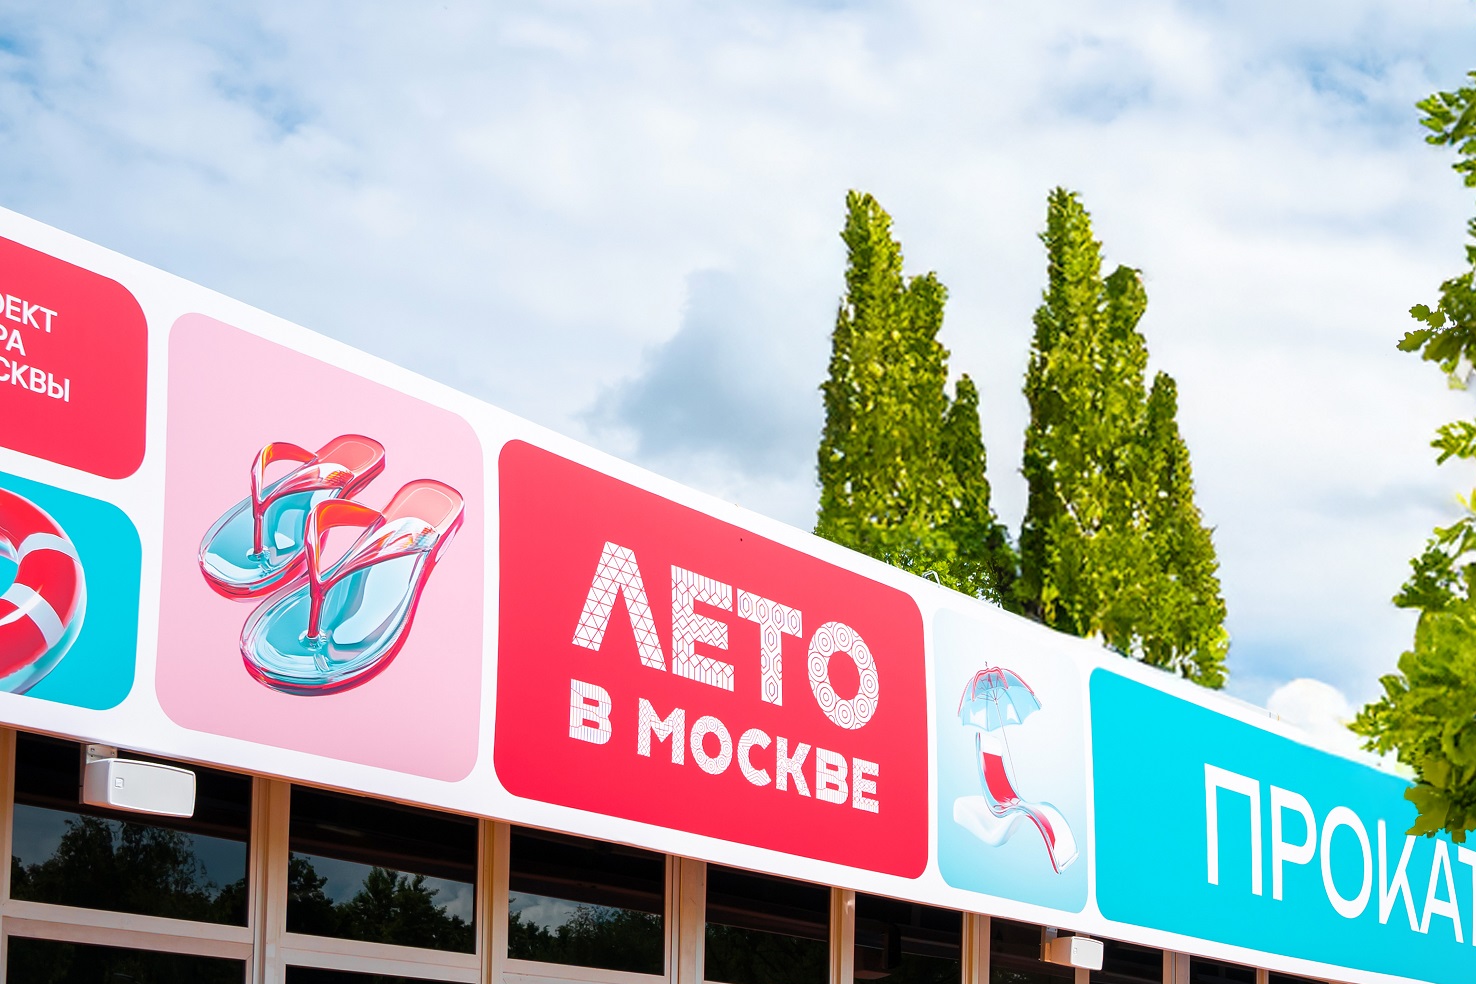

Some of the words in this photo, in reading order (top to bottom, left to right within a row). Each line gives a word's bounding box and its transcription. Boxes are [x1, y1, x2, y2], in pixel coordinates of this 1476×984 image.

[0, 293, 58, 334] ЕКТ
[0, 356, 70, 403] СКВЫ
[571, 540, 880, 731] ЛЕТО
[568, 678, 613, 746] В
[637, 697, 880, 814] МОСКВЕ
